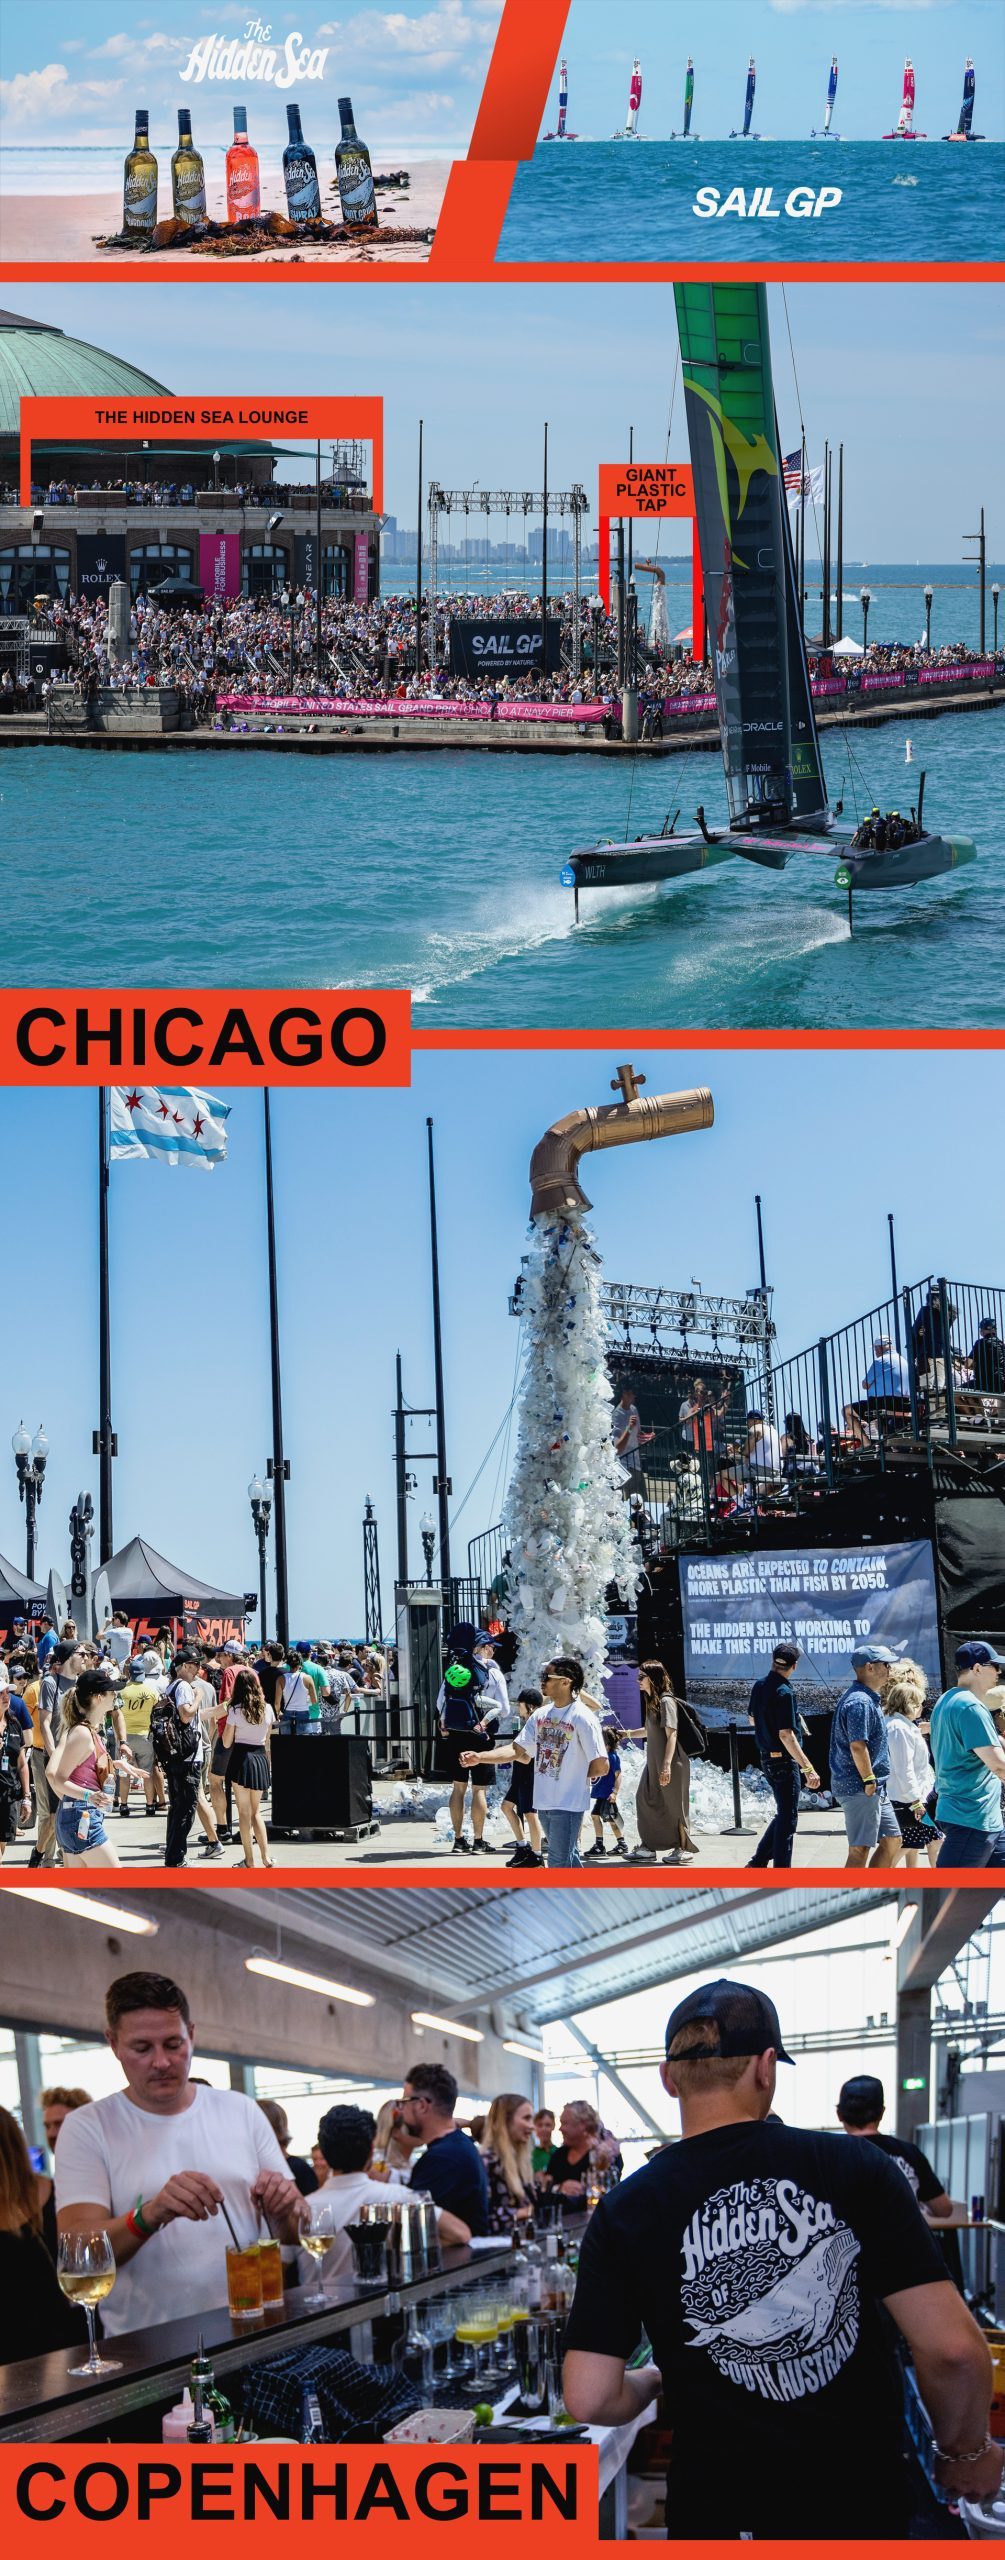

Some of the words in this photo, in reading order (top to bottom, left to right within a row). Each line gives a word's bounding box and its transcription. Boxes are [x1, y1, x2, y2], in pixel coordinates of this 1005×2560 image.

[82, 574, 121, 583] ROLEX
[335, 702, 373, 712] STATES
[374, 703, 396, 713] SAIL
[398, 704, 433, 714] GRAND
[524, 707, 551, 717] NAVY
[552, 708, 574, 717] PIER
[687, 1563, 729, 1580] OCEANS
[732, 1561, 755, 1578] ARE
[758, 1559, 809, 1577] EXPECTED
[813, 1558, 828, 1575] TO
[831, 1556, 887, 1574] CONTAIN
[687, 1579, 719, 1596] MORE
[722, 1577, 766, 1595] PLASTIC
[770, 1576, 800, 1593] THAN
[803, 1575, 829, 1592] FISH
[831, 1574, 847, 1591] BY
[852, 1573, 889, 1590] 2050.
[690, 1622, 710, 1638] THE
[713, 1621, 754, 1638] HIDDEN
[757, 1621, 777, 1637] SEA
[781, 1621, 792, 1637] IS
[795, 1619, 851, 1636] WORKING
[855, 1619, 871, 1635] TO
[691, 1639, 722, 1655] MAKE
[724, 1638, 750, 1655] THIS
[729, 2180, 761, 2207] The
[680, 2204, 780, 2281] Hidden
[775, 2179, 836, 2257] Sea
[718, 2357, 787, 2402] SOUTH
[776, 2315, 860, 2402] AUSTRALIA
